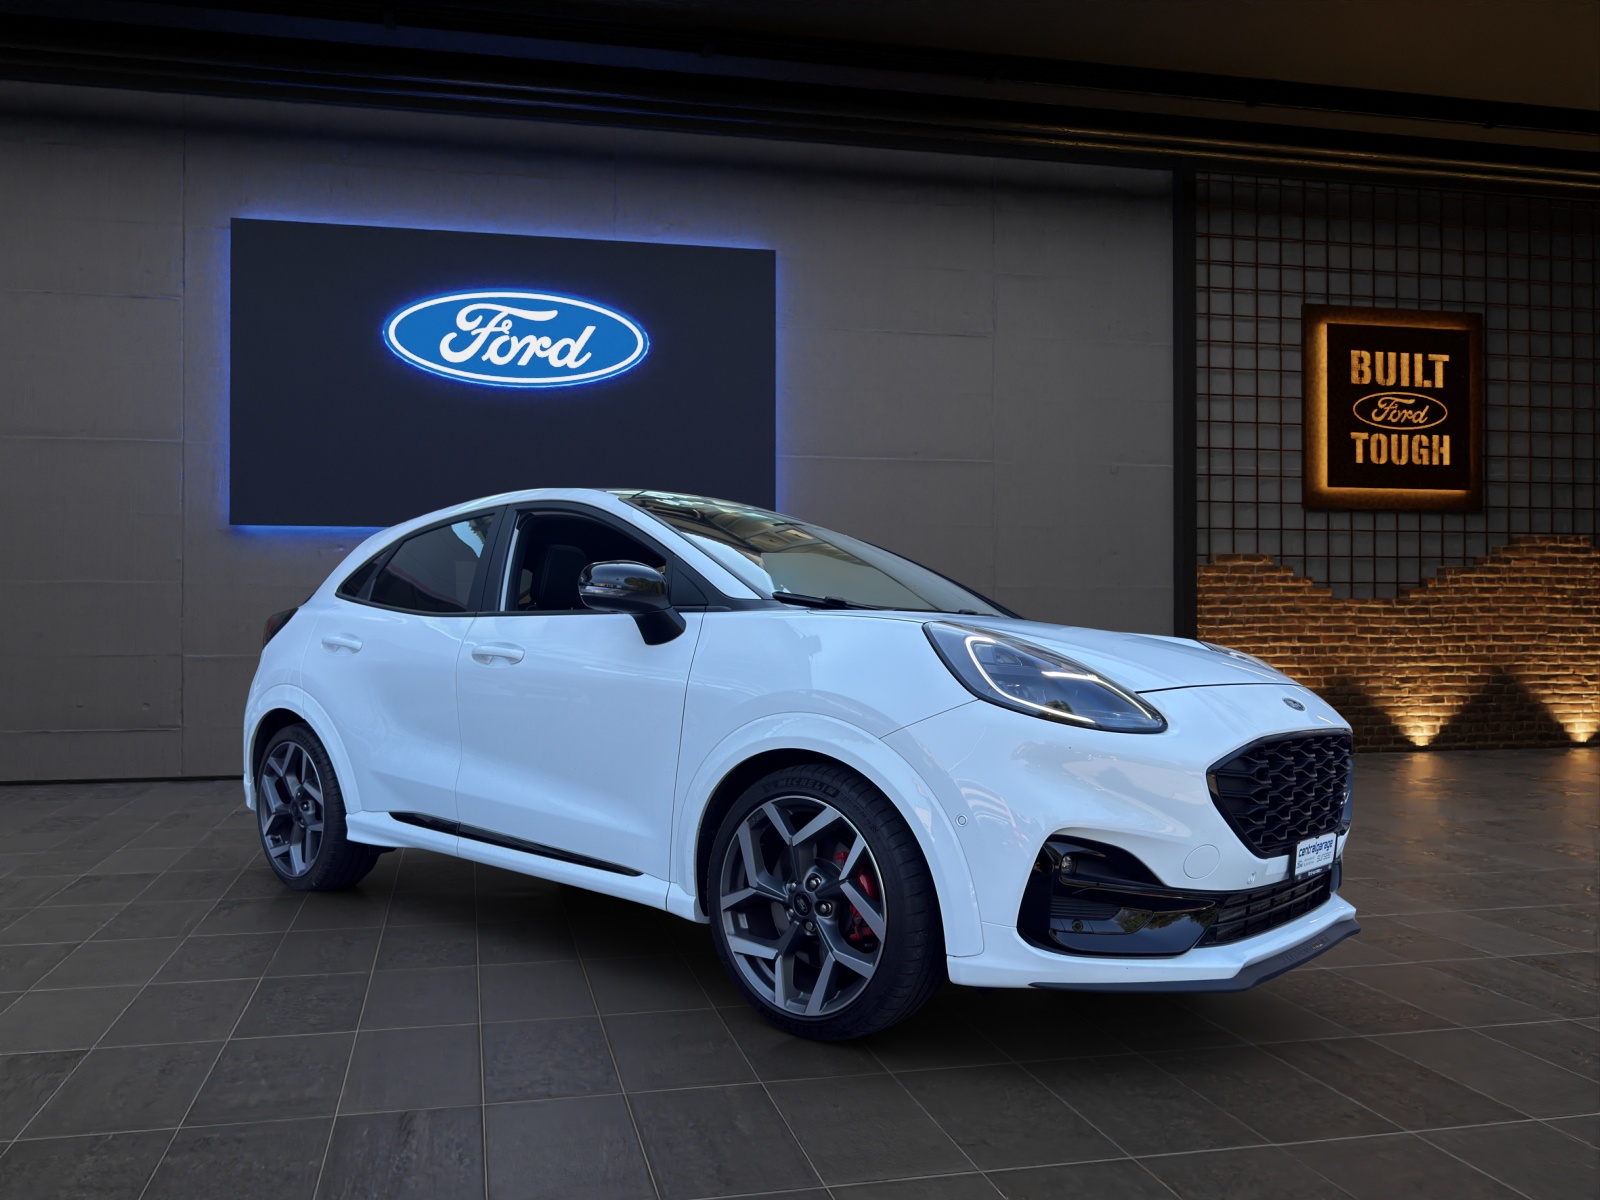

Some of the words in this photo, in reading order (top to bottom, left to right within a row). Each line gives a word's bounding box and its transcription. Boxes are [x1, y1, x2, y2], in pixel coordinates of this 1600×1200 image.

[439, 302, 596, 369] Ford
[1350, 350, 1450, 389] BUILT
[1371, 396, 1430, 424] Ford
[1350, 432, 1450, 466] TOUGH
[777, 778, 839, 797] MICHELIN
